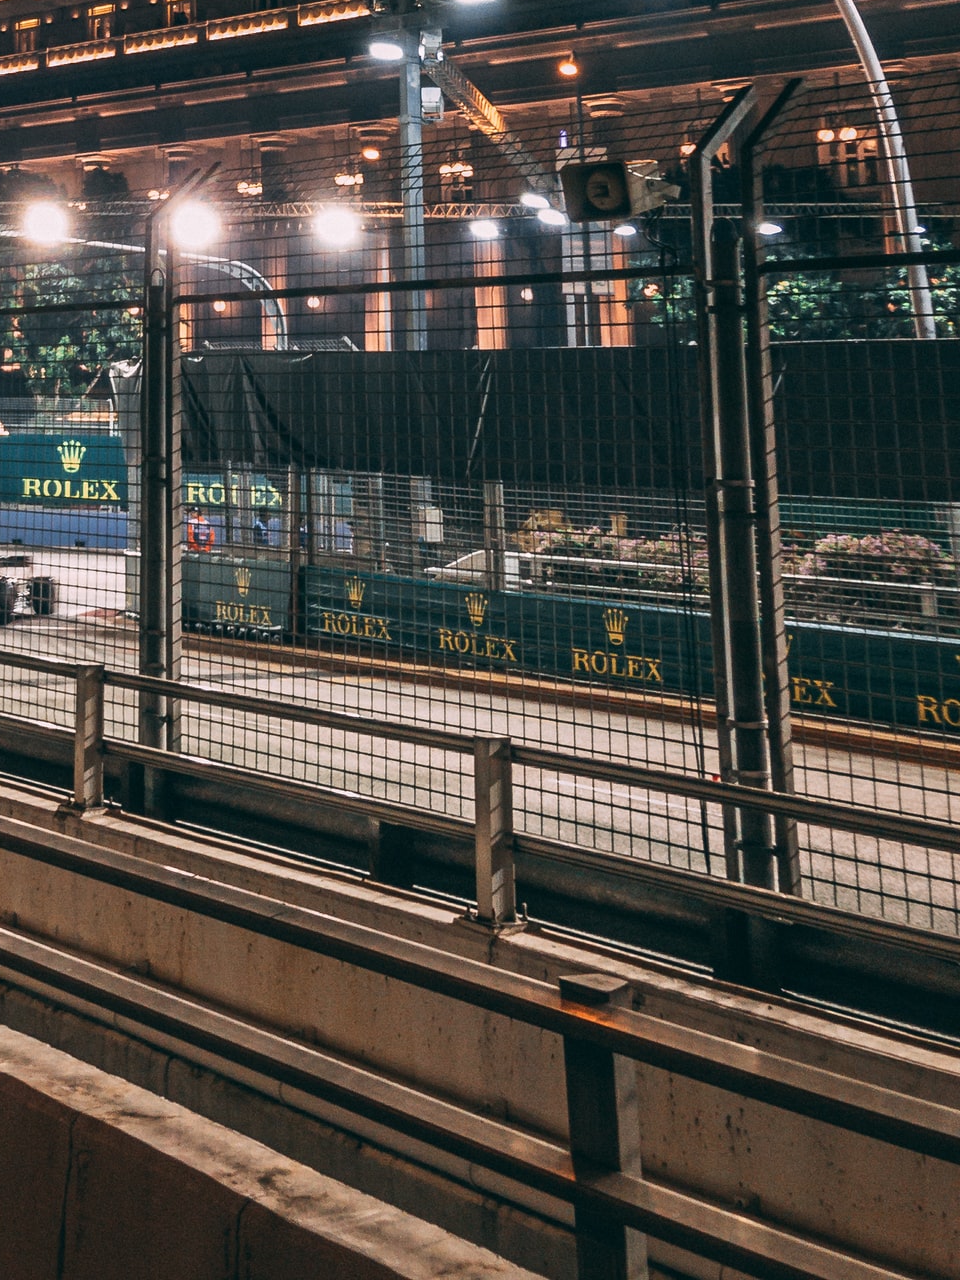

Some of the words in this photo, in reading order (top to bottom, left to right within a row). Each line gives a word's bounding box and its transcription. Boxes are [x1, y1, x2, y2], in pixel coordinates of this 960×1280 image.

[21, 478, 121, 500] ROLEX
[215, 600, 273, 625] ROLEX
[322, 612, 392, 641] ROLEX
[438, 628, 517, 662] ROLEX
[571, 648, 663, 682] ROLEX
